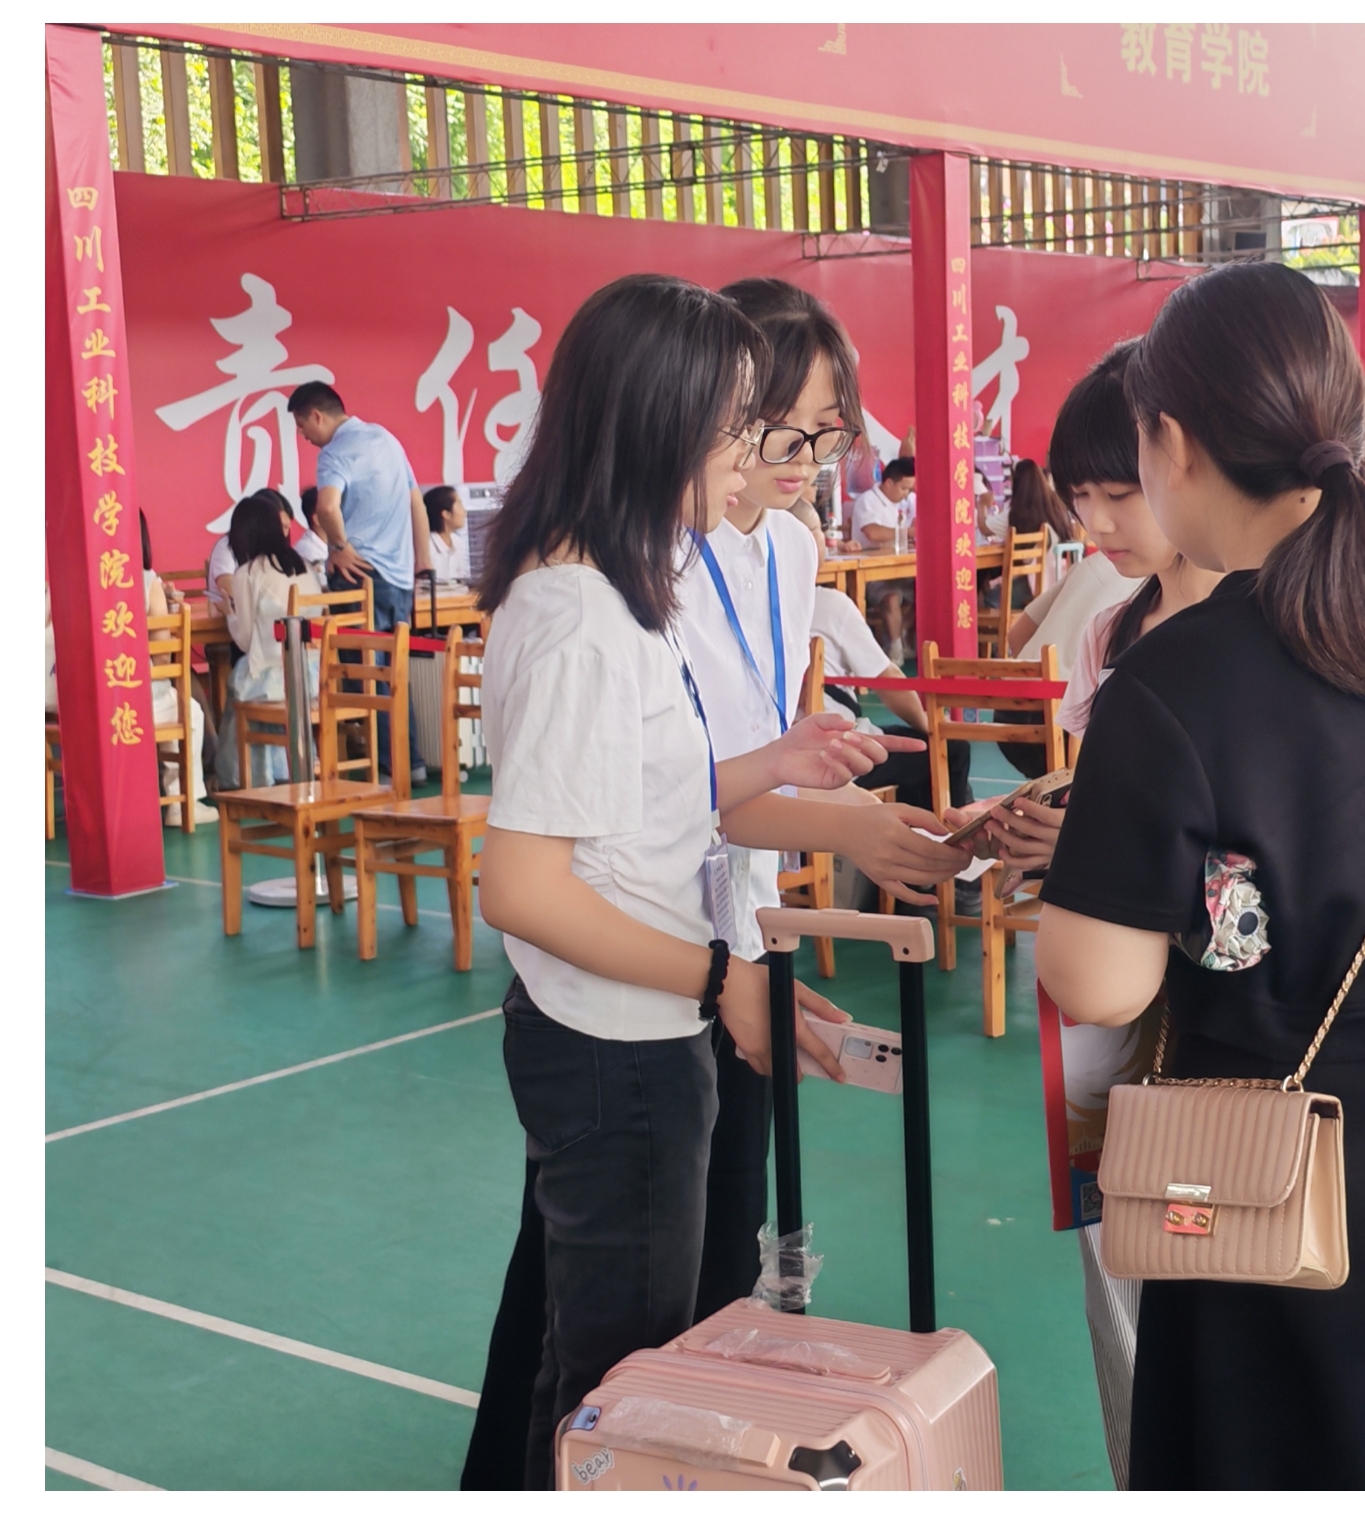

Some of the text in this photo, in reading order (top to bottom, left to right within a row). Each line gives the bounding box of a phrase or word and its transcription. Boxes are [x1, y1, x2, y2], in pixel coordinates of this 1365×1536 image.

[1119, 23, 1270, 98] 教育学院
[66, 186, 144, 748] 四川工业科技学院欢迎您
[949, 257, 975, 630] 四川工业科技学院欢迎您
[572, 1449, 614, 1484] bear
